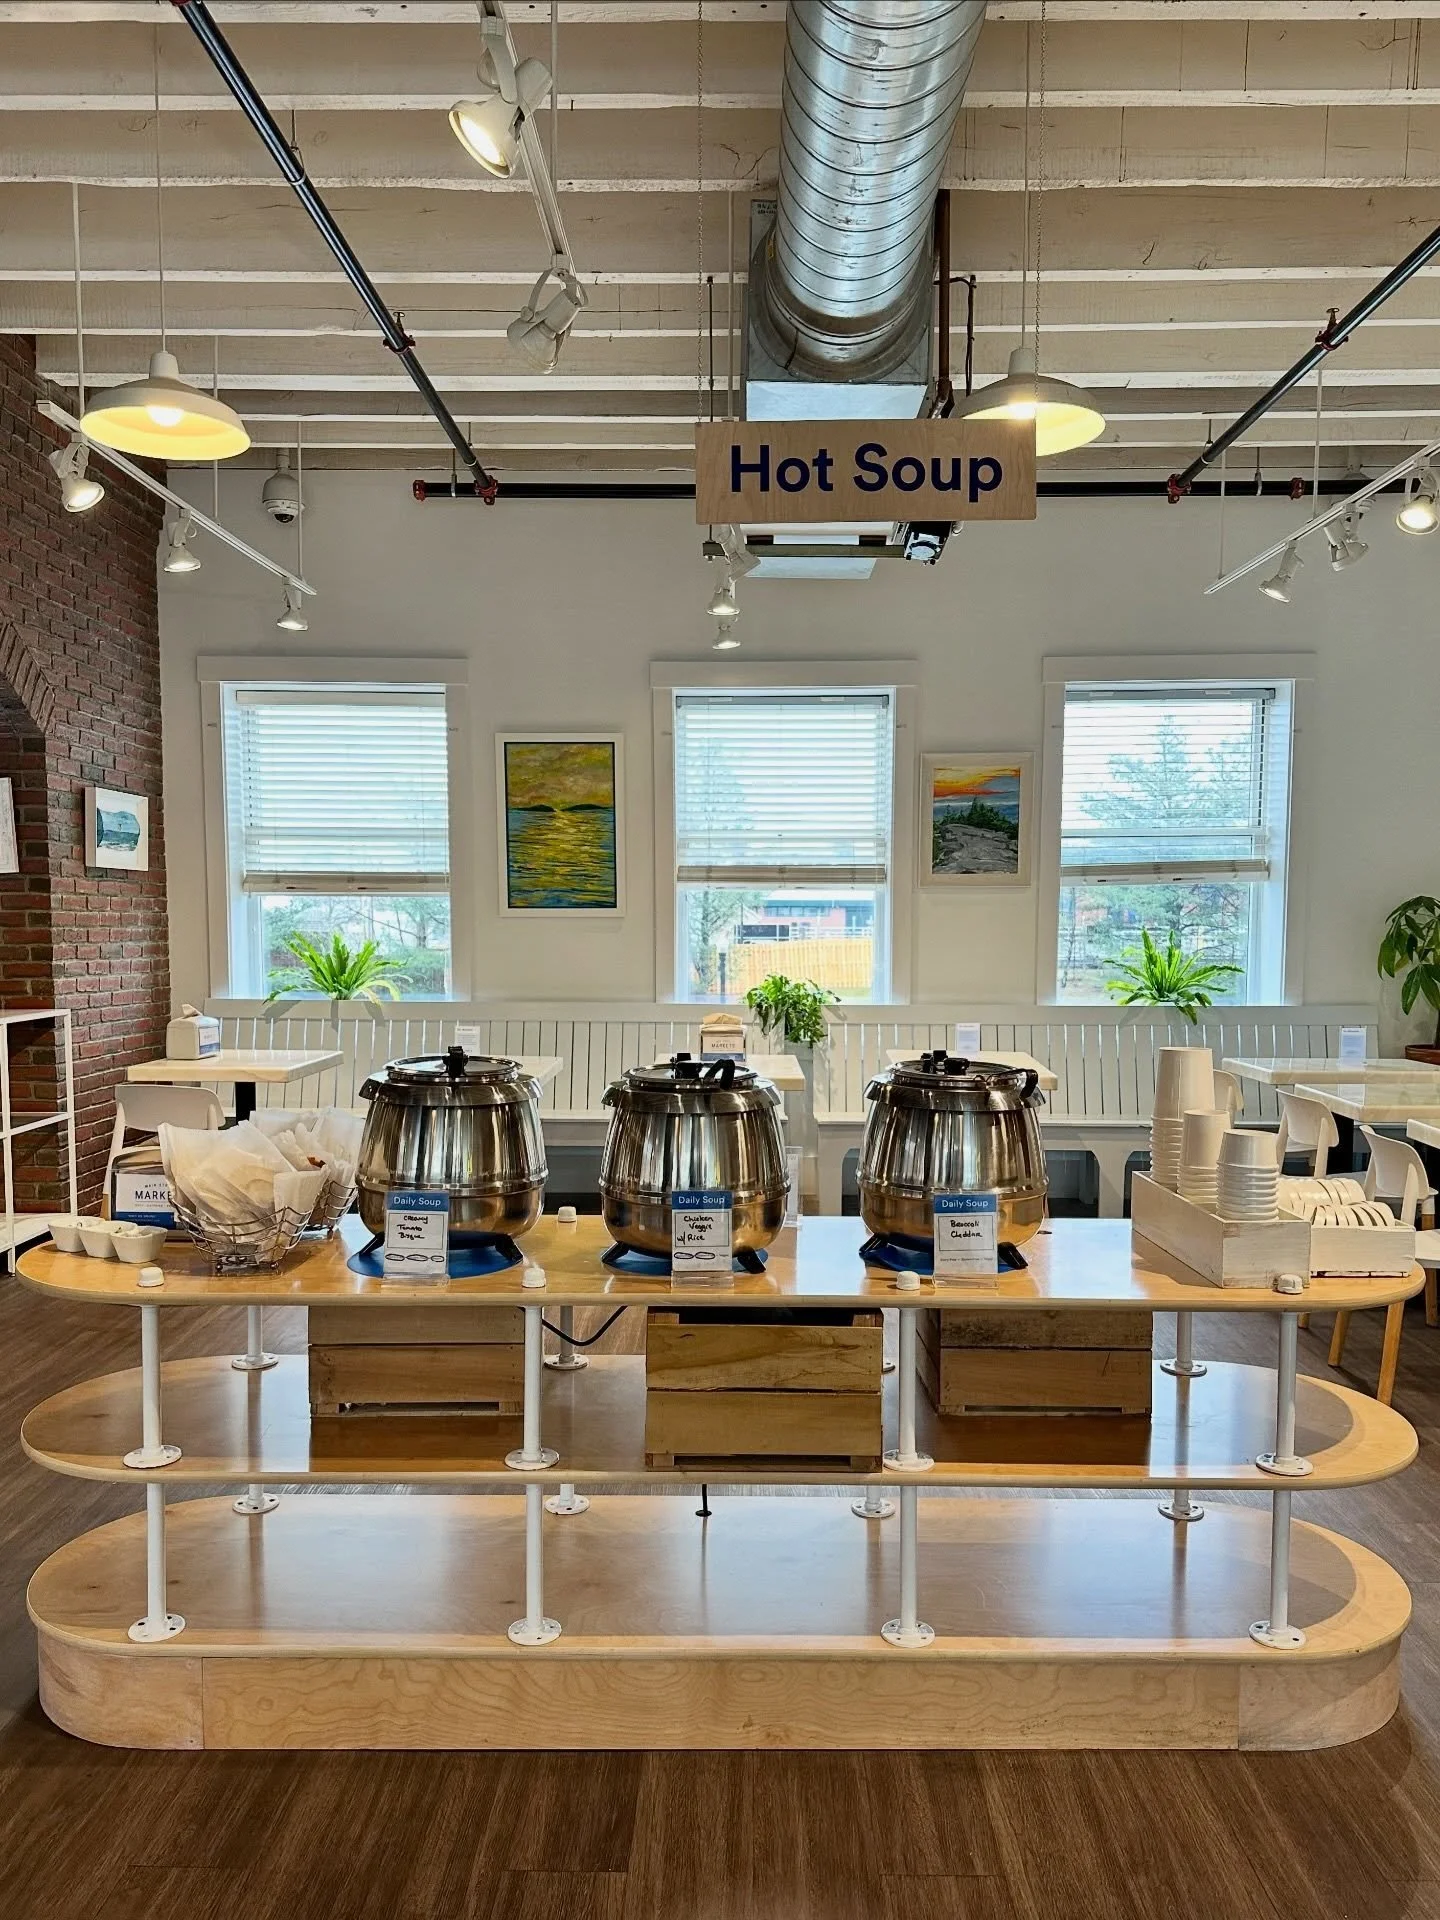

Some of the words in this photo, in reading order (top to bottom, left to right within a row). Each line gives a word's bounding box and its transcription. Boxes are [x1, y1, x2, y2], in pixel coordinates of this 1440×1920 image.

[730, 444, 834, 493] Hot
[853, 442, 1003, 504] Soup
[135, 1190, 172, 1200] MARKE
[678, 1196, 700, 1205] Daily
[702, 1195, 725, 1205] Soup
[393, 1196, 417, 1206] Daily
[418, 1197, 441, 1207] Soup
[941, 1199, 963, 1209] Daily
[966, 1199, 989, 1208] Soup
[689, 1222, 712, 1233] Veggie
[676, 1231, 686, 1245] w/
[687, 1233, 705, 1242] Rice
